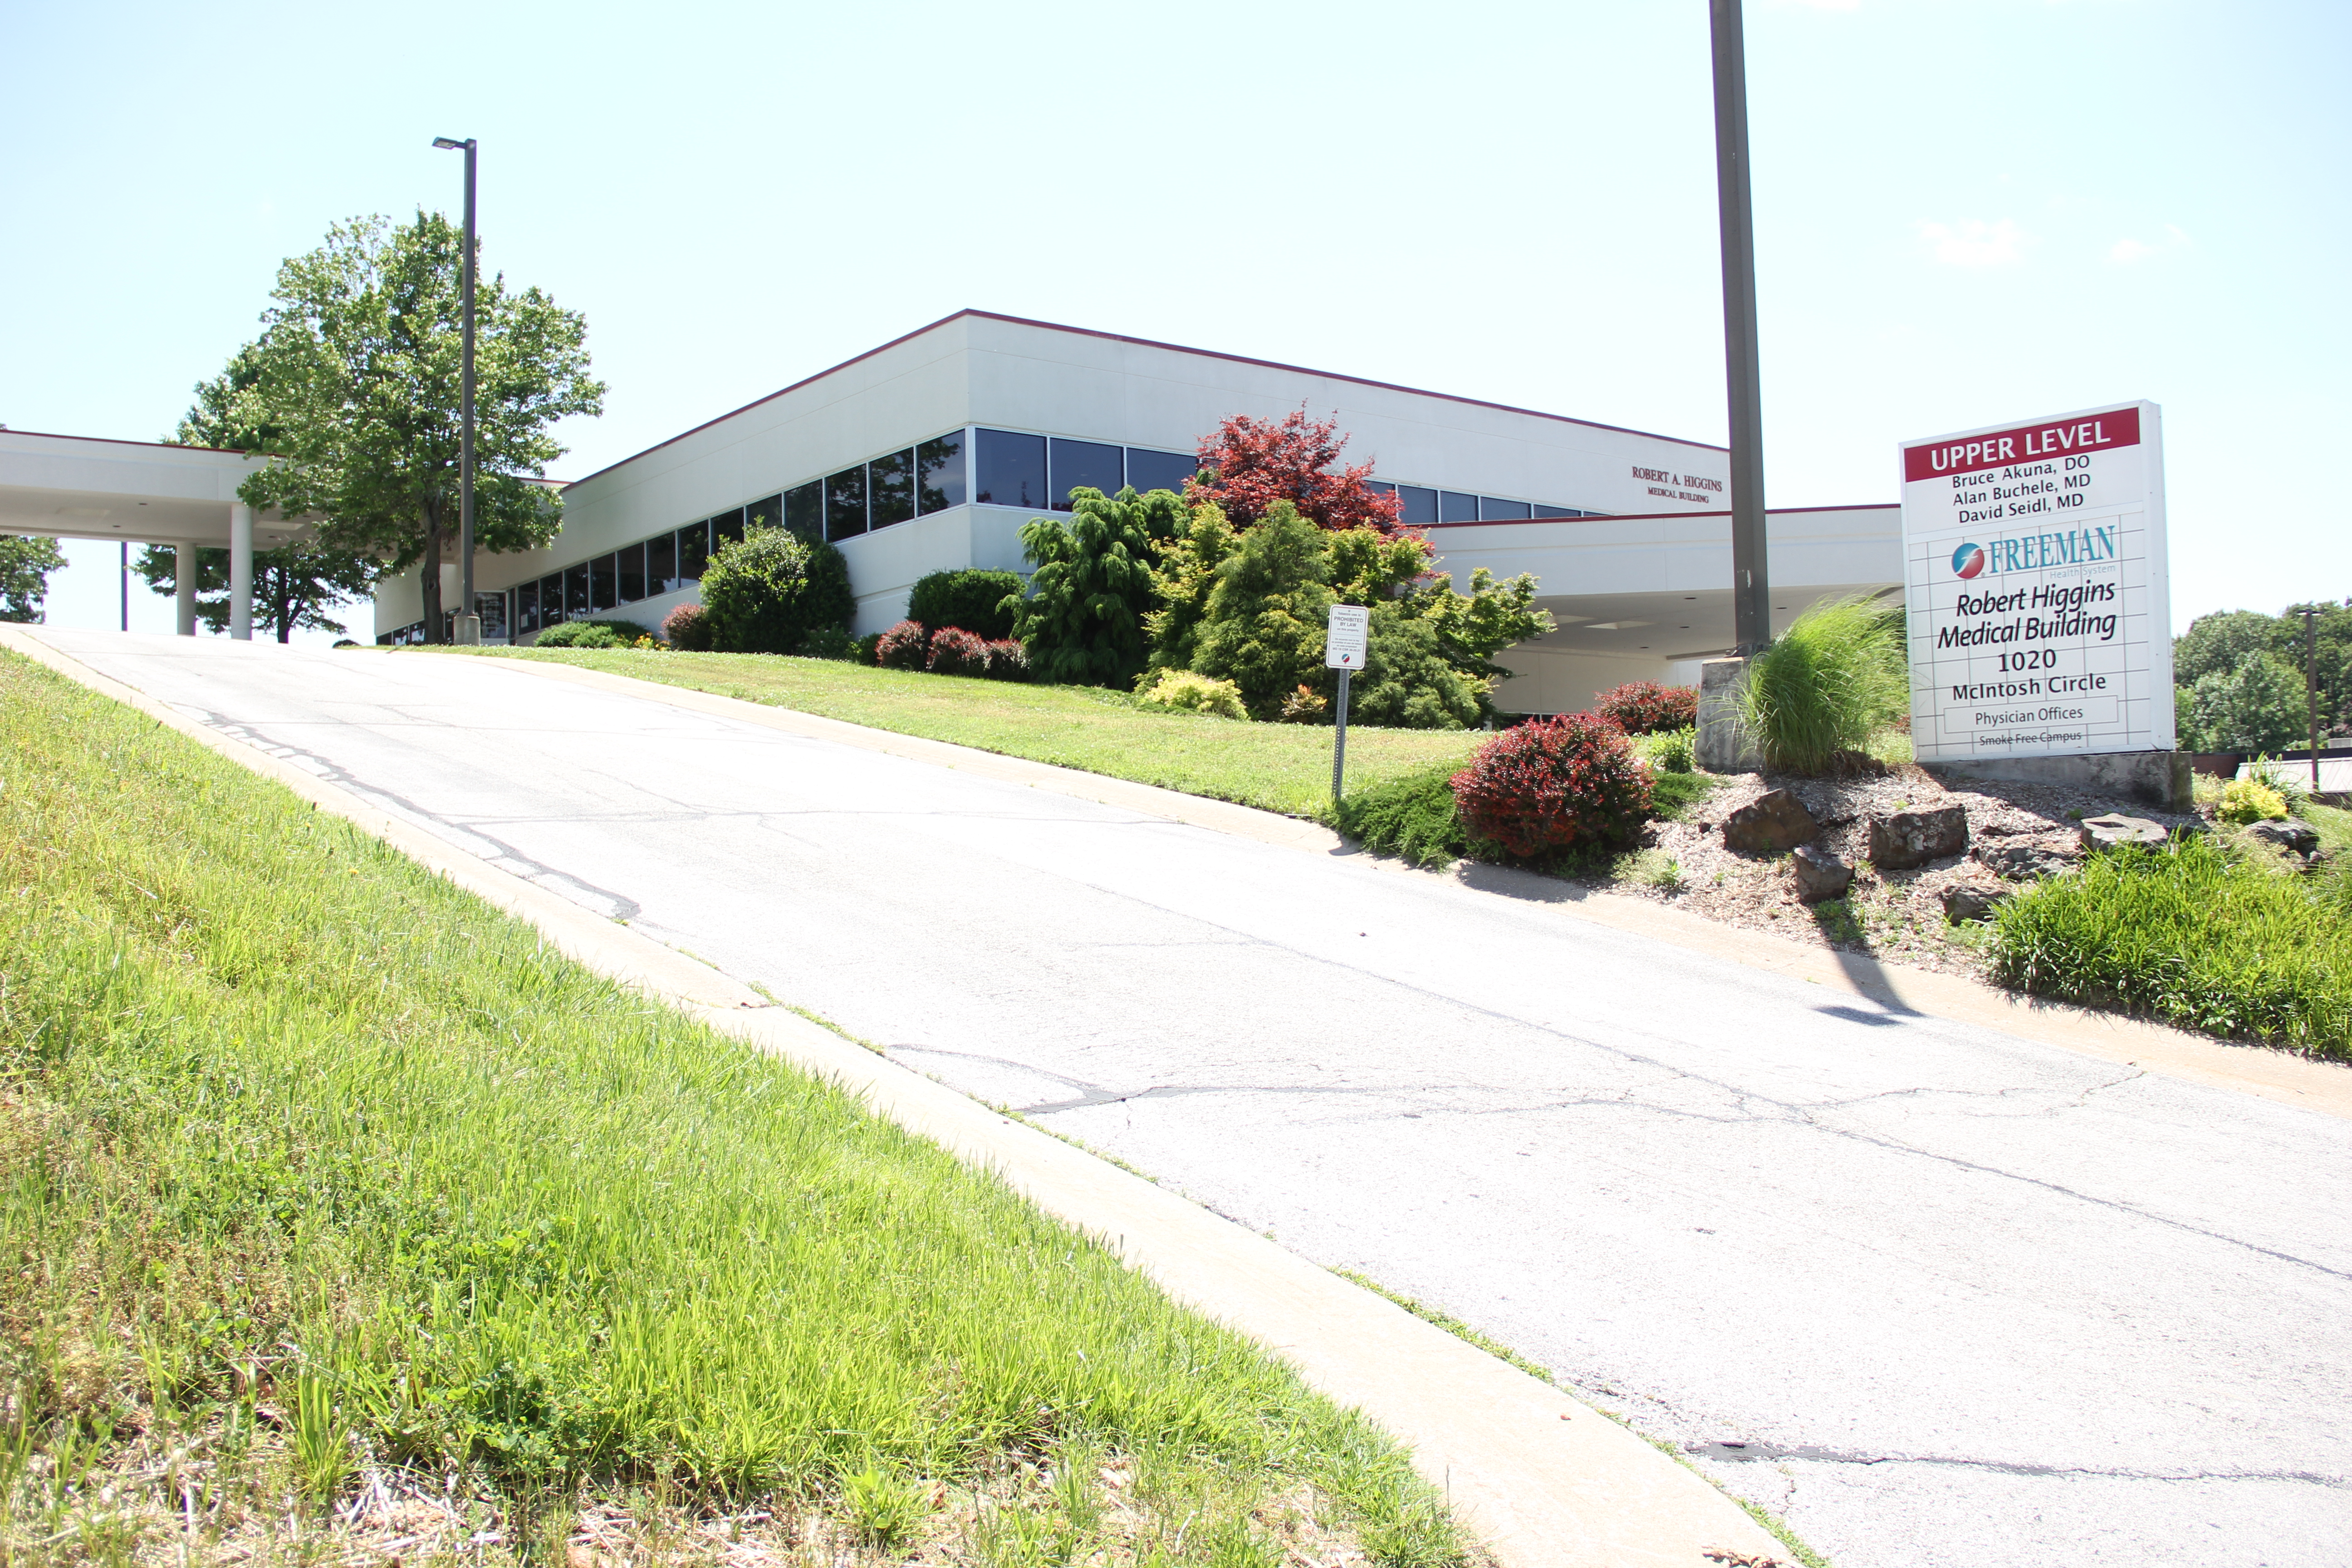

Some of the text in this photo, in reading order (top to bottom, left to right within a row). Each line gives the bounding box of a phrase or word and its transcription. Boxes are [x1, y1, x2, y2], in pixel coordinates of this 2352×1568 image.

[1931, 421, 2111, 471] UPPER LEVEL
[1632, 466, 1722, 491] ROBERT A. HIGGINS
[1952, 455, 2089, 488] Bruce Akuna, DO
[1647, 487, 1709, 503] MEDICAL BUILDING
[1953, 474, 2090, 506] Alan Buchele, MD
[1959, 493, 2083, 523] David Seidl, MD
[1988, 525, 2115, 573] FREEMAN
[2050, 564, 2115, 578] Health System
[1956, 579, 2115, 617] Robert Higgins
[1937, 611, 2116, 648] Medical Building
[1998, 649, 2056, 672] 1020
[1953, 673, 2107, 701] McIntosh Circle
[1975, 706, 2083, 727] Physician Offices
[1980, 732, 2081, 745] Smoke Free Campus
